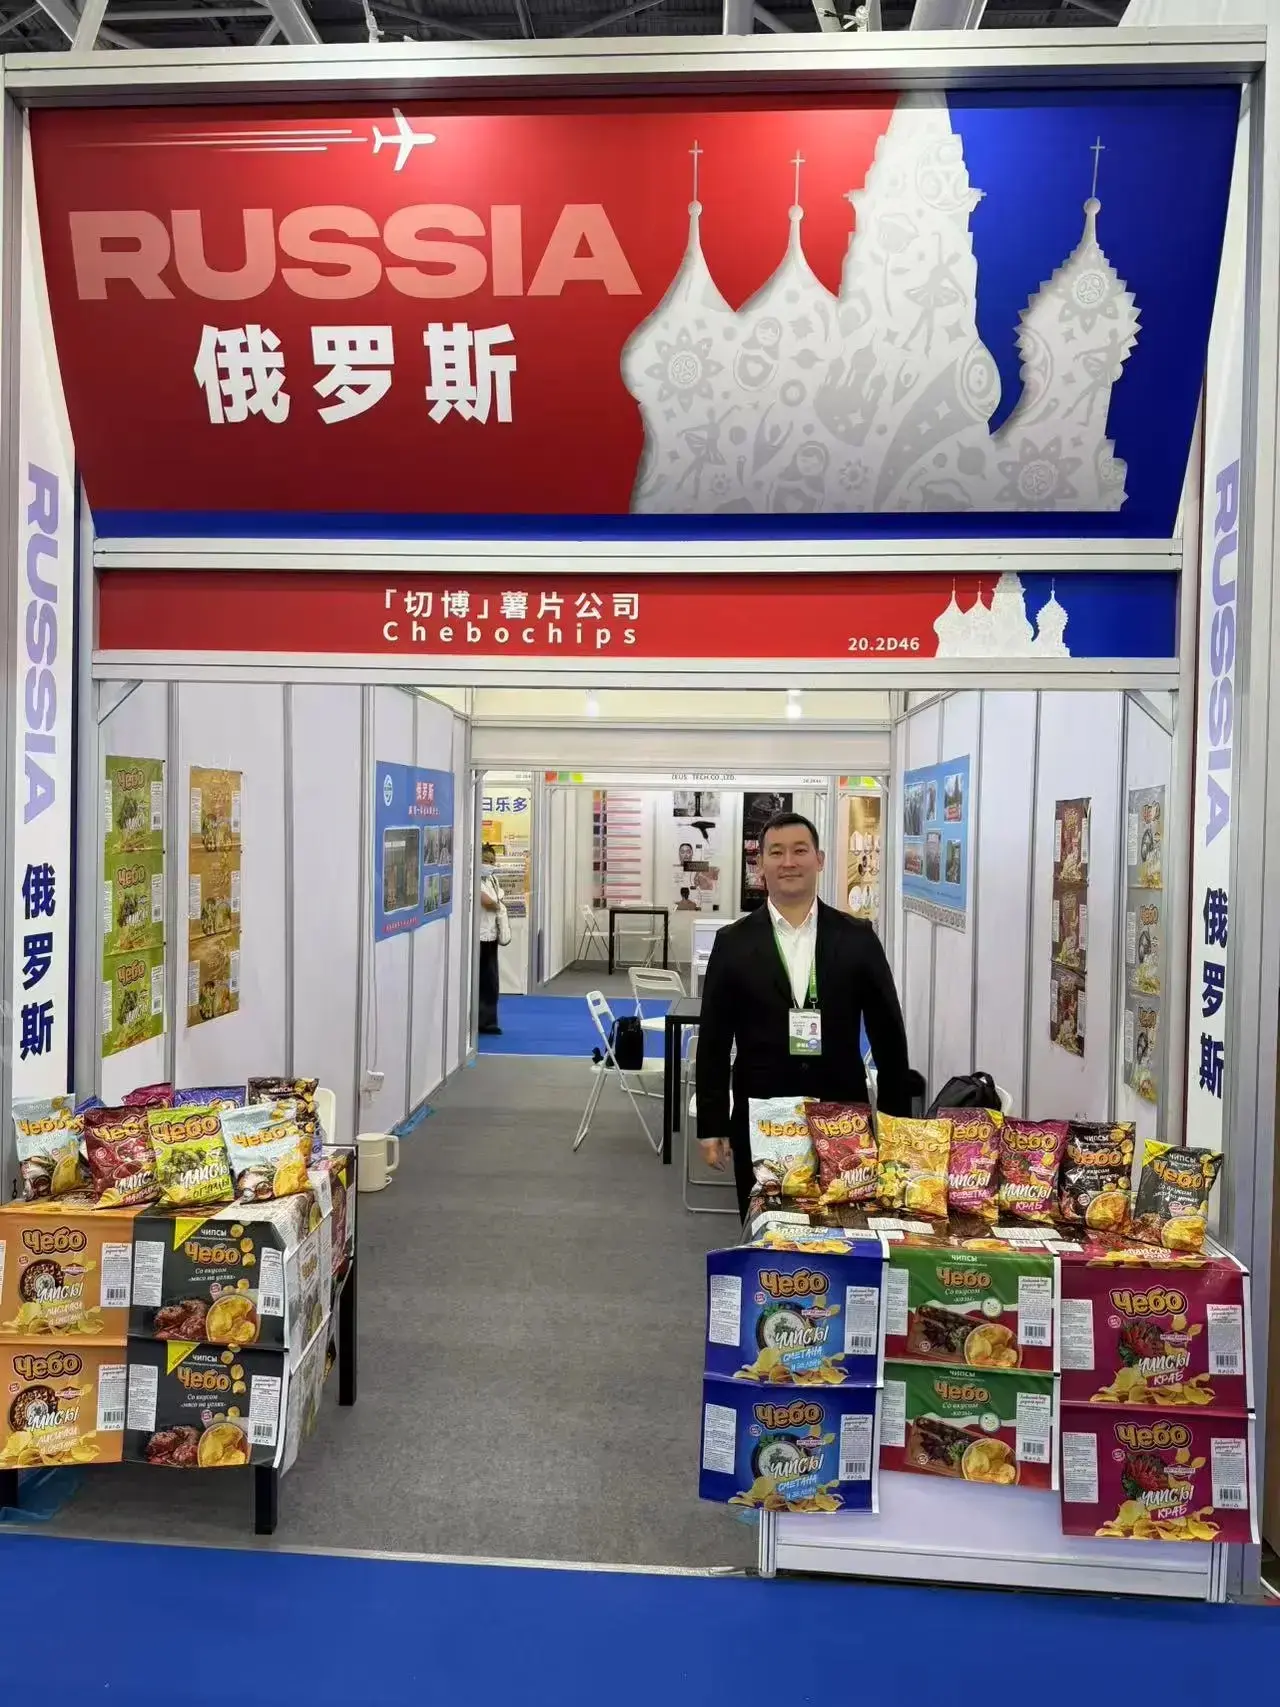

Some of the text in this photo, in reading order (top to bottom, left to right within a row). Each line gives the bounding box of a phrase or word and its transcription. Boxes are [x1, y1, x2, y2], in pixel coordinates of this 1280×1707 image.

[69, 203, 643, 301] RUSSIA
[194, 321, 518, 426] 俄罗斯
[384, 588, 641, 621] 「切博」薯片公司
[24, 461, 60, 825] RUSSIA
[382, 620, 638, 649] Chebochips
[847, 636, 920, 652] 20.2D46
[1205, 458, 1241, 848] RUSSIA
[20, 862, 57, 1061] 俄罗斯
[1199, 887, 1229, 1100] 俄罗斯
[18, 1113, 67, 1137] Чебо
[151, 1115, 222, 1145] Чебо
[232, 1126, 287, 1148] Чебо
[757, 1119, 810, 1137] Чебо
[811, 1113, 870, 1138] Чебо
[1001, 1126, 1058, 1152] Чебо
[1067, 1144, 1123, 1167] Чебо
[1153, 1159, 1205, 1189] Чебо
[1015, 1201, 1043, 1211] КРАБ
[22, 1226, 87, 1255] Чебо
[201, 1229, 227, 1237] ЧИПСЫ
[184, 1241, 241, 1266] Чебо
[951, 1254, 978, 1263] ЧИПСЫ
[758, 1267, 830, 1298] Чебо
[935, 1265, 993, 1290] Чебо
[1109, 1285, 1188, 1318] Чебо
[13, 1350, 83, 1381] Чебо
[192, 1354, 218, 1362] ЧИПСЫ
[177, 1366, 232, 1393] Чебо
[949, 1370, 976, 1378] ЧИПСЫ
[1153, 1371, 1184, 1385] КРАБ
[934, 1379, 991, 1403] Чебо
[753, 1399, 825, 1430] Чебо
[1114, 1419, 1193, 1451] Чебо
[1157, 1505, 1187, 1520] КРАБ
